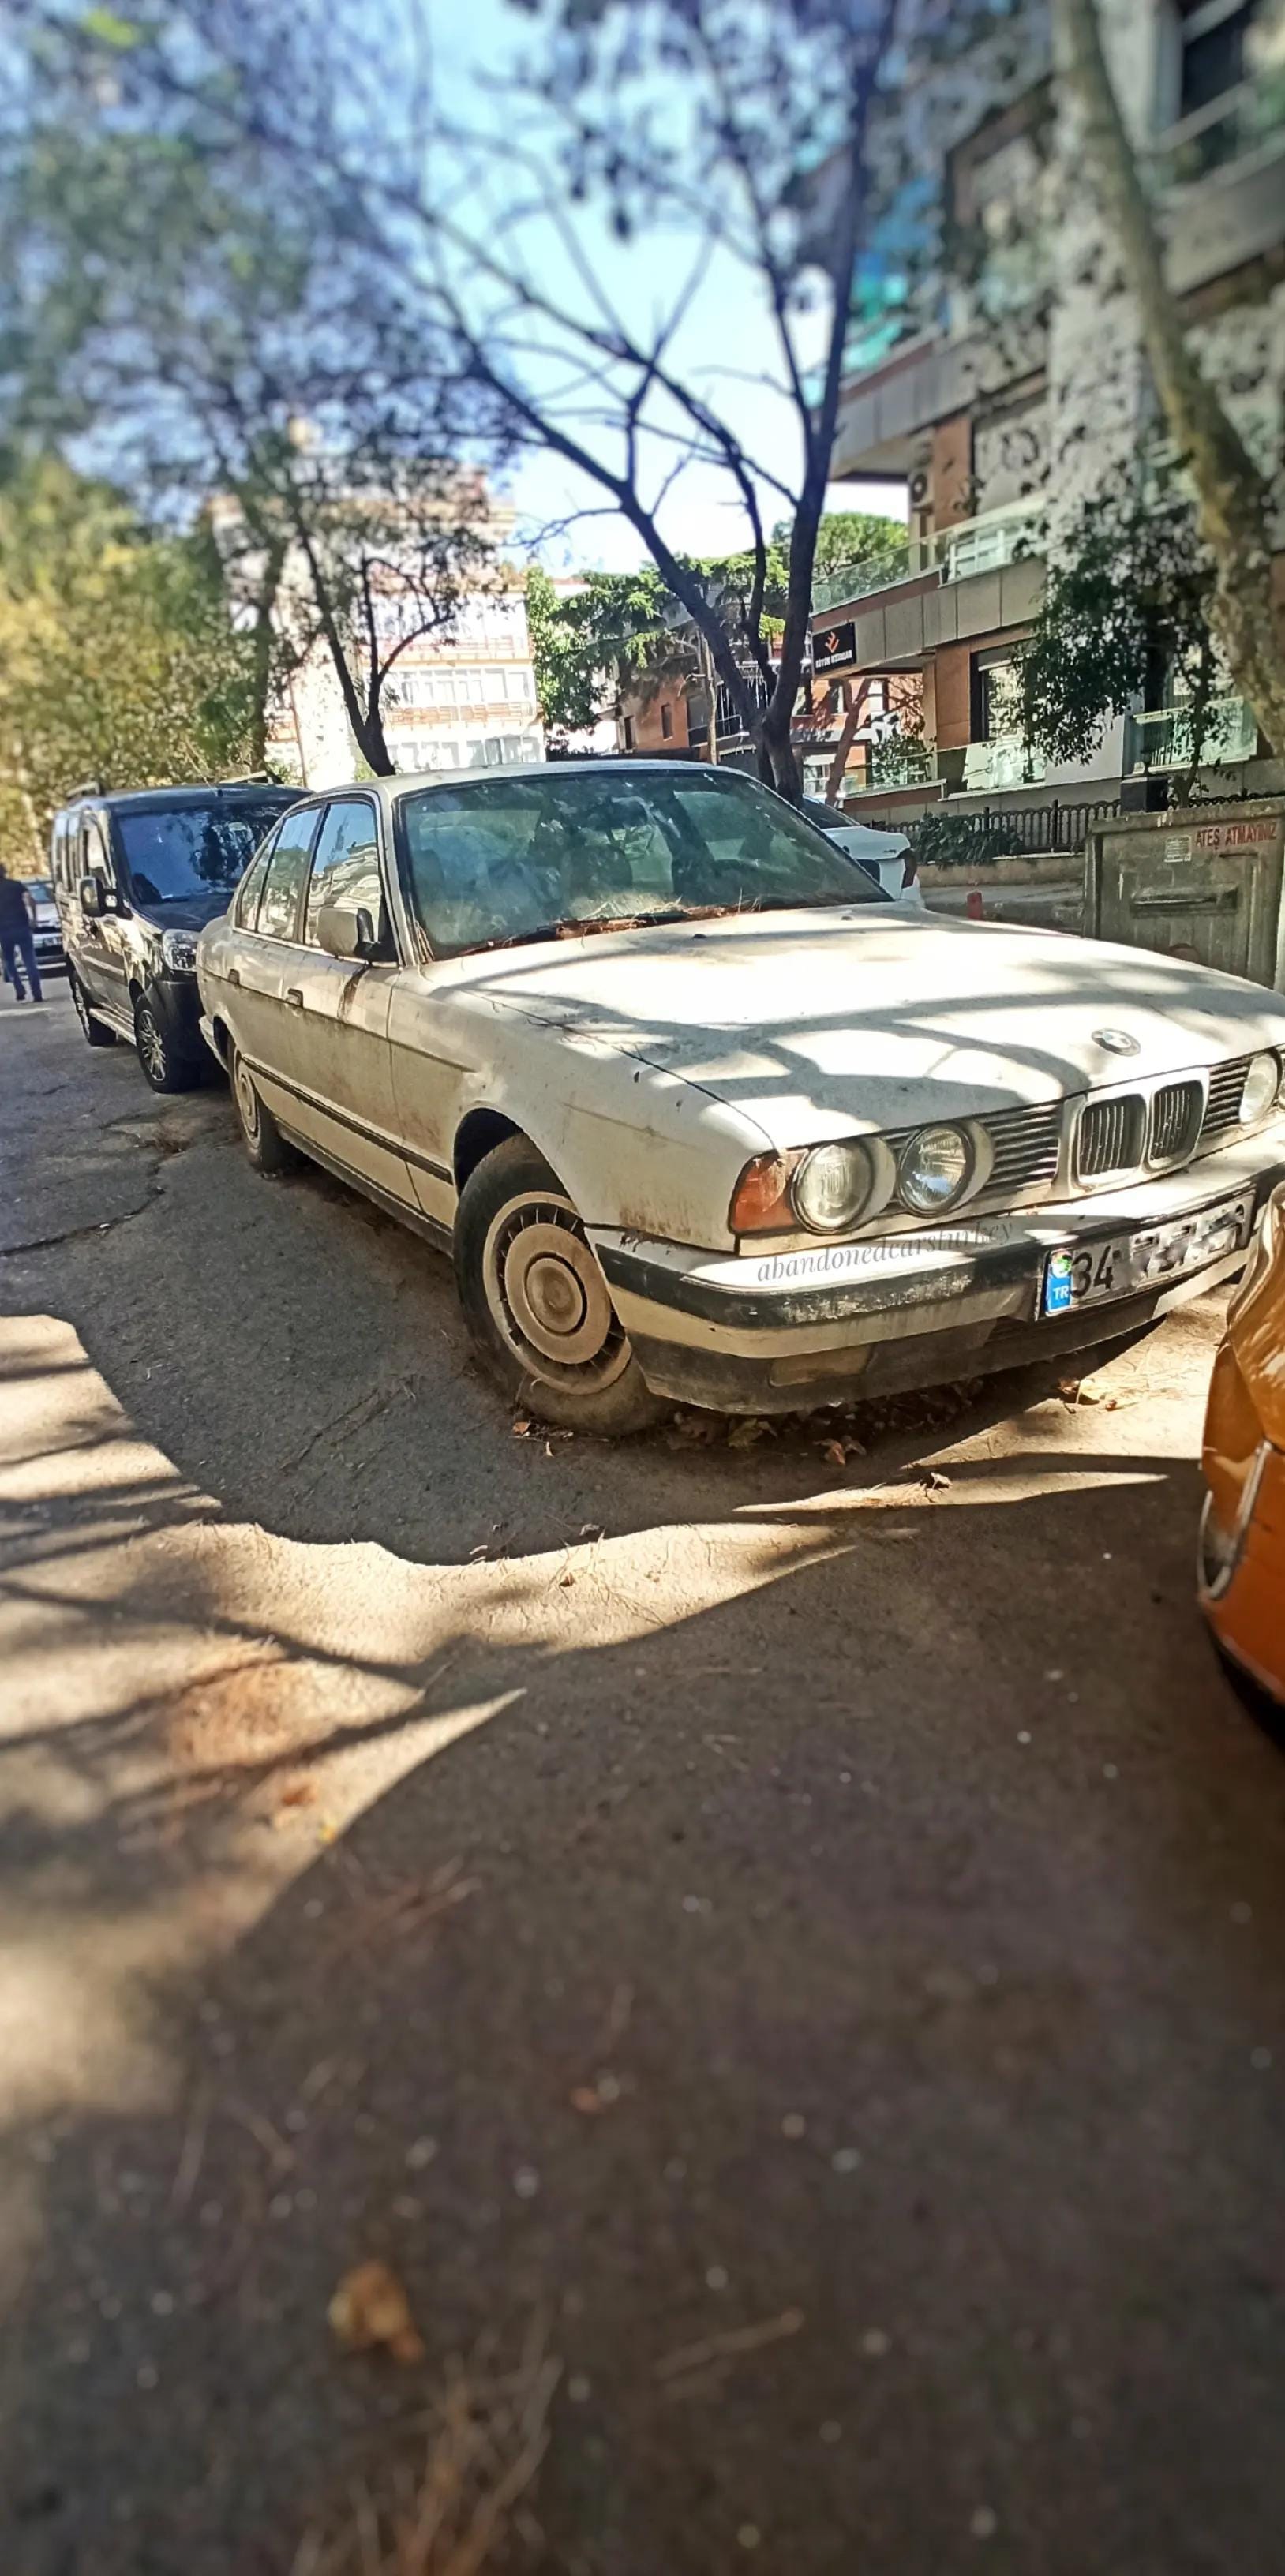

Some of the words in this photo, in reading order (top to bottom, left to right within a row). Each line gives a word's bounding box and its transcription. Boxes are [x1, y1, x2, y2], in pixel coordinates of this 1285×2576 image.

[1195, 828, 1220, 850] ATEŞ
[1225, 822, 1277, 846] ATMAYINIZ
[1071, 1245, 1114, 1299] 34
[1053, 1285, 1070, 1300] TR
